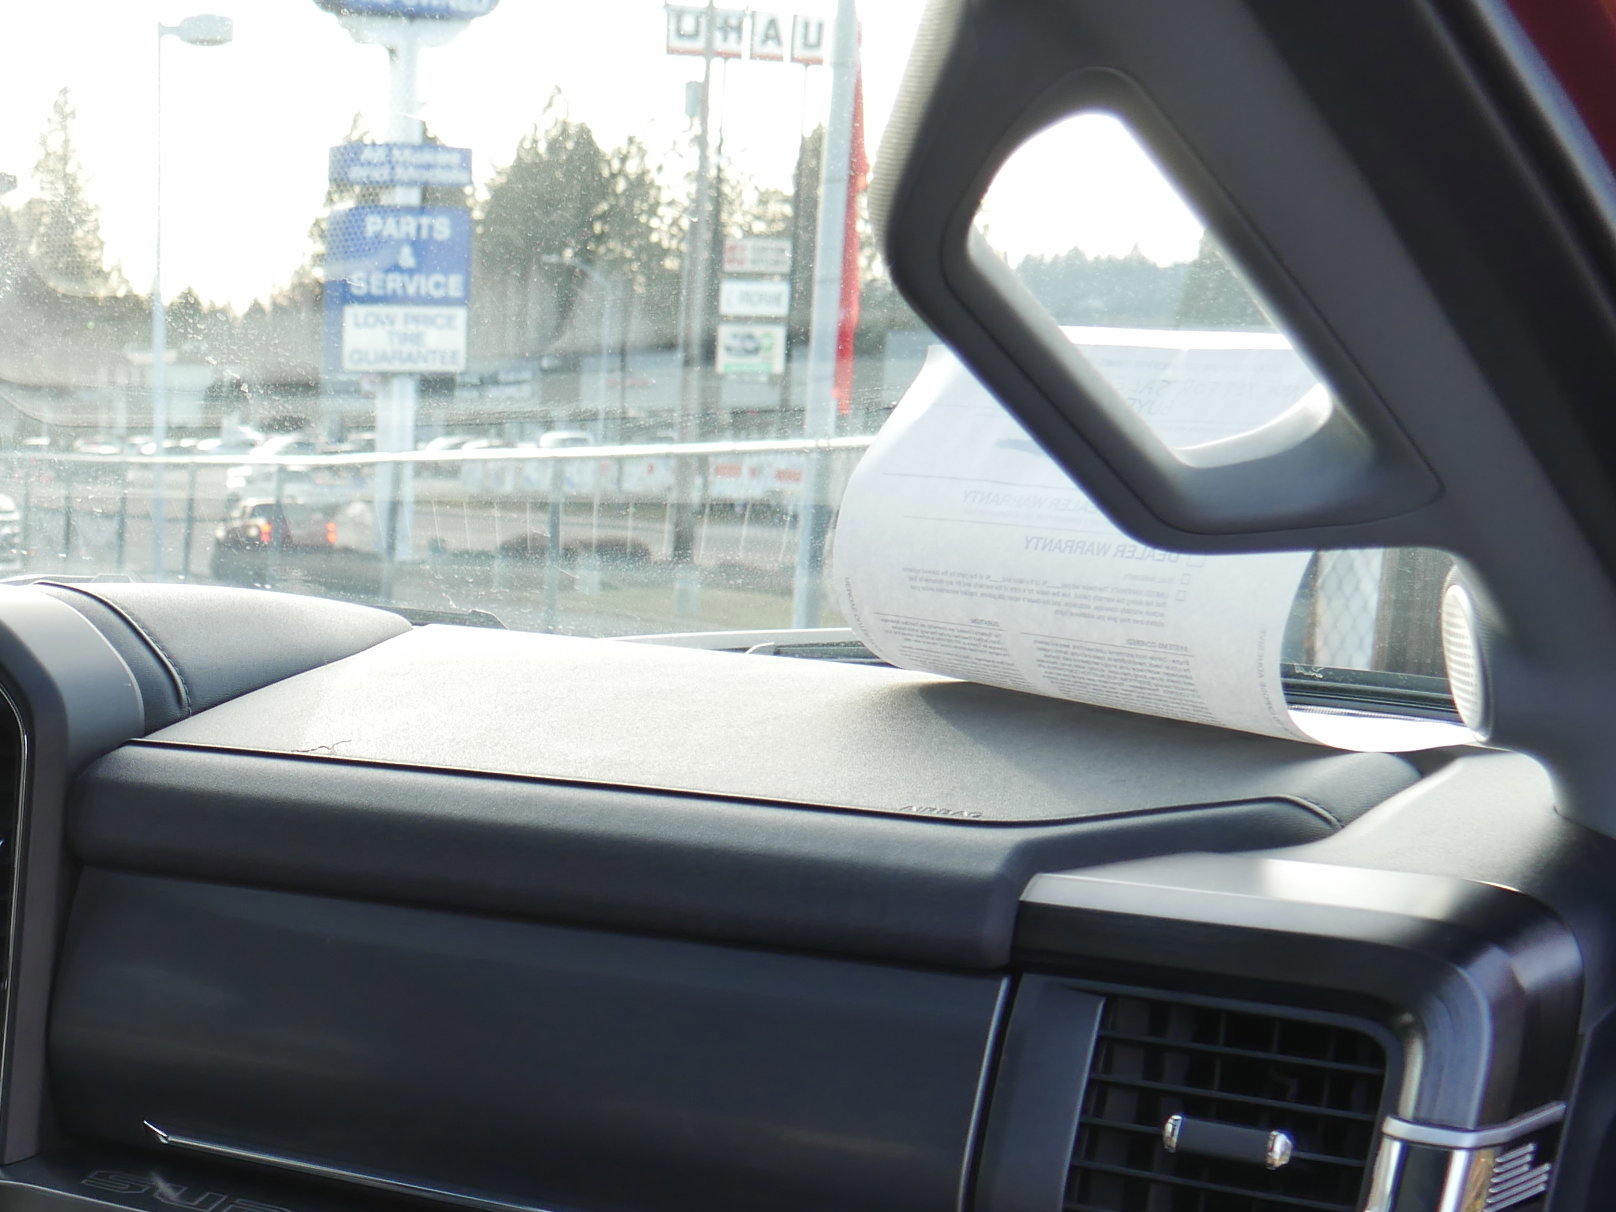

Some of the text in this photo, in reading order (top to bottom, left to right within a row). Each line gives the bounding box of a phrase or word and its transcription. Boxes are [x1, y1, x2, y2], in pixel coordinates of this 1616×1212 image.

[363, 213, 451, 241] PARTS
[397, 244, 417, 269] &
[348, 270, 464, 298] SERVICE
[353, 312, 458, 330] LOW PRICE
